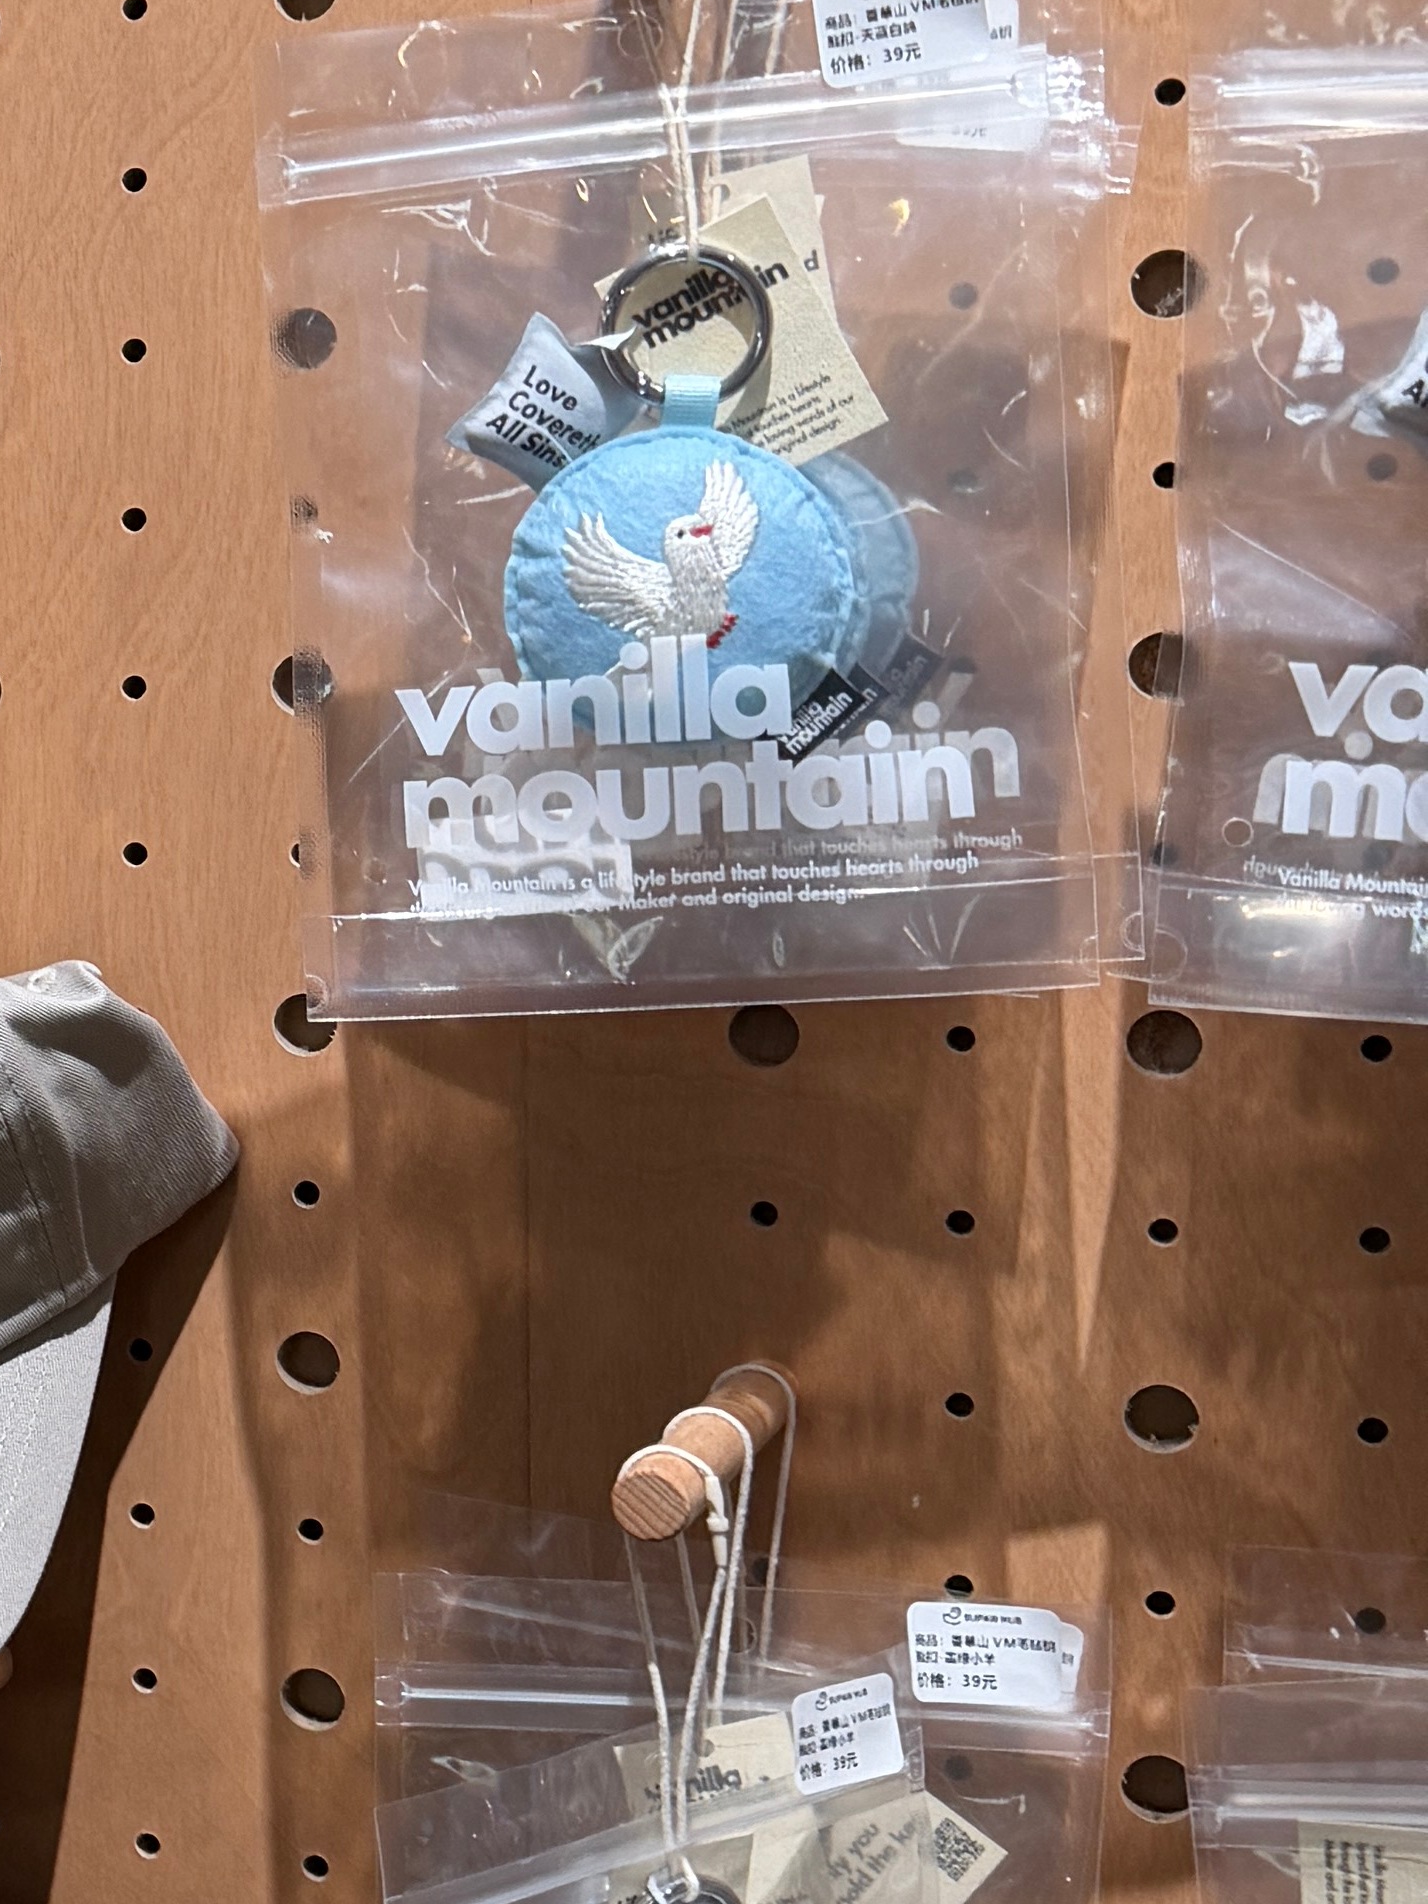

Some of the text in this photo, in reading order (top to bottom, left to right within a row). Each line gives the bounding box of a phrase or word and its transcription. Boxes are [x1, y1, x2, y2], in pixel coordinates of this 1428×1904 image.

[883, 42, 922, 64] 39元
[631, 267, 734, 330] vanilla
[523, 365, 579, 413] Love
[486, 412, 525, 447] All
[508, 389, 599, 455] Covereth
[395, 634, 792, 760] vanilla
[785, 691, 853, 755] mountain
[403, 720, 977, 852] mountain
[671, 851, 980, 887] brand that touches hearts through
[681, 884, 794, 910] and original
[962, 1674, 998, 1691] 39元
[833, 1752, 859, 1772] 39元
[849, 1822, 880, 1859] you
